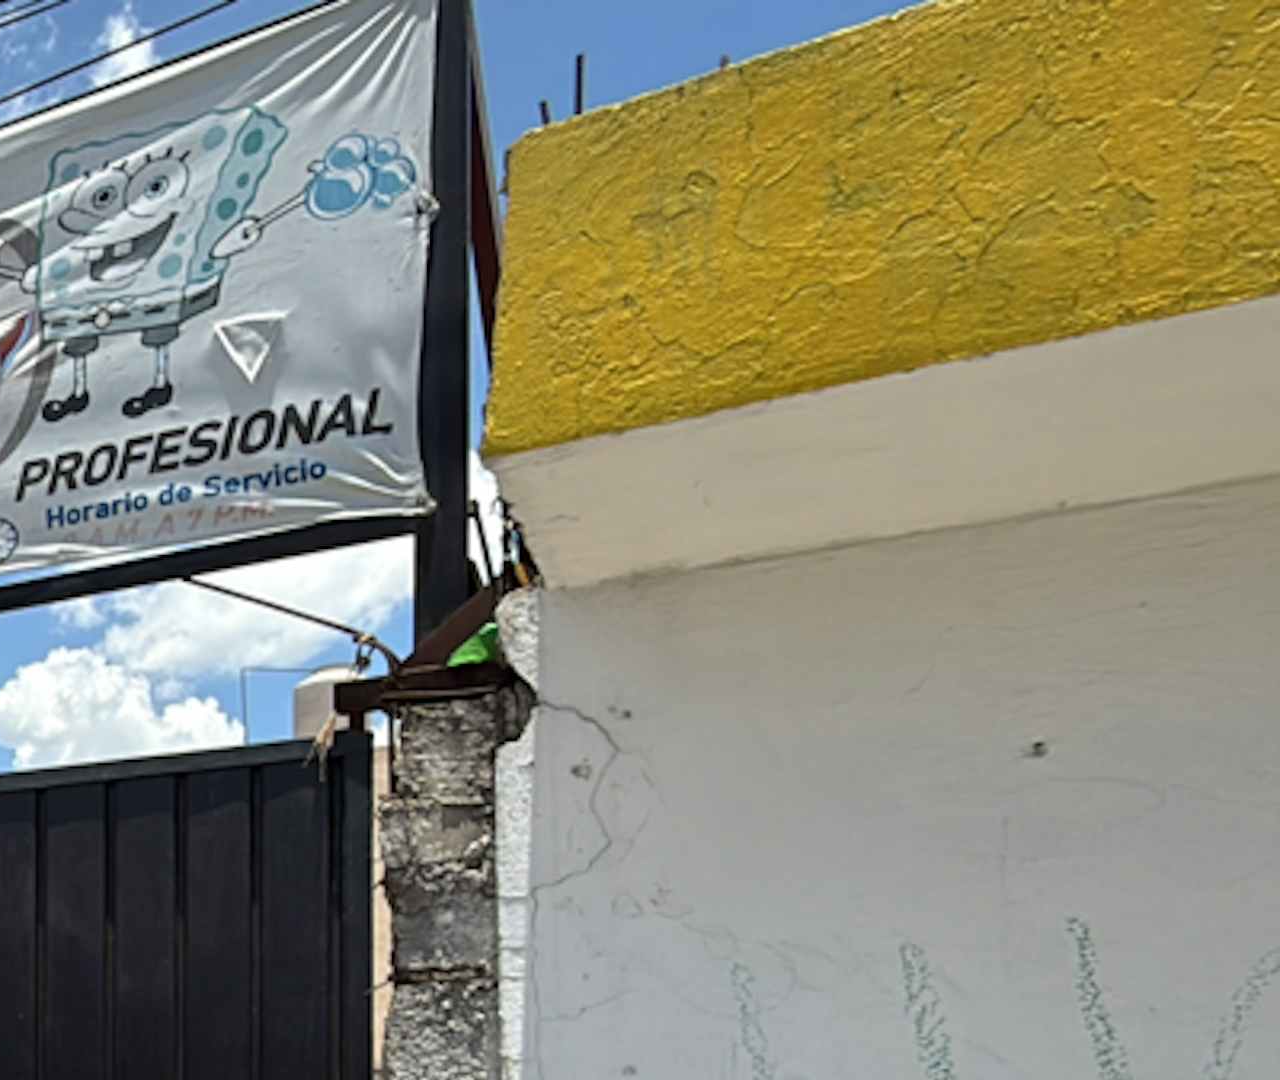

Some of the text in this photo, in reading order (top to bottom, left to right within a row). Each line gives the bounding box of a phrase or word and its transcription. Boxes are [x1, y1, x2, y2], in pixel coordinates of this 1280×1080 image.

[14, 388, 393, 502] PROFESIONAL
[47, 459, 327, 529] Horario de Servicio
